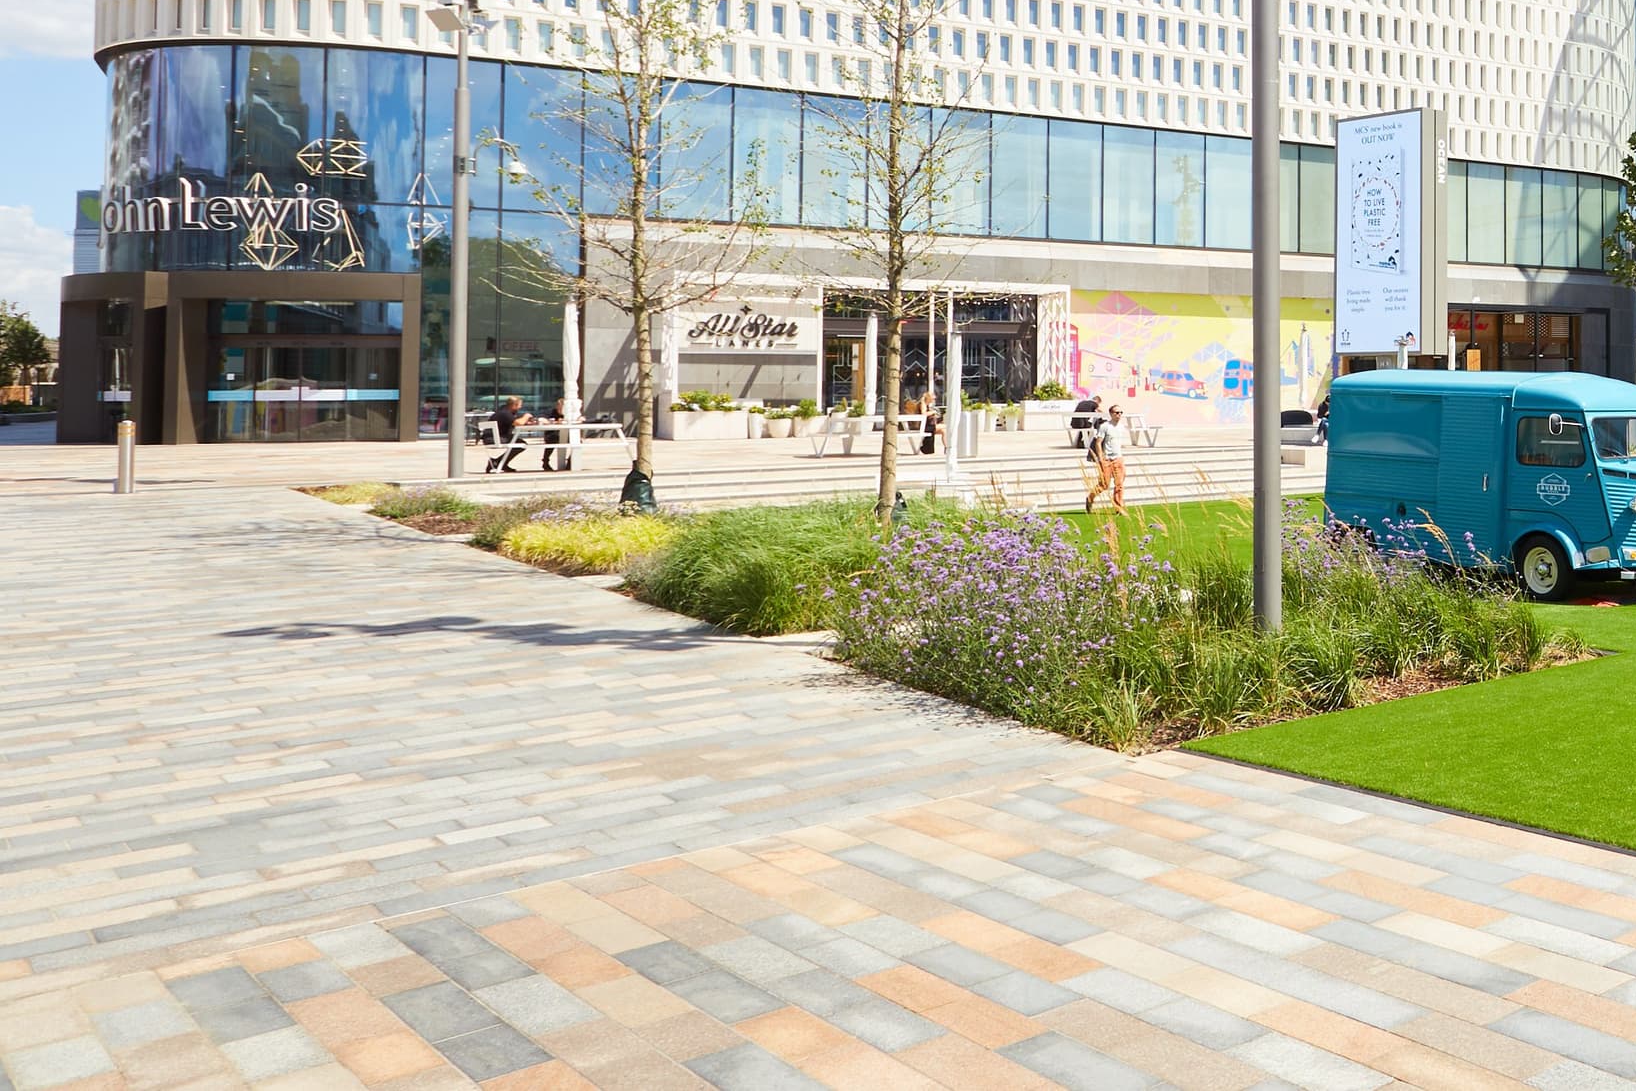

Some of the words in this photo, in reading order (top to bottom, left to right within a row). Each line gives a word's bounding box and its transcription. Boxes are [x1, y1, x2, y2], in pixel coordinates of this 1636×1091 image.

[1438, 139, 1446, 184] OCEAN
[1366, 189, 1382, 197] HOW
[100, 185, 170, 234] ohn
[180, 178, 340, 232] Lewis
[1373, 198, 1385, 207] LIVE
[1363, 208, 1386, 217] PLASTIC
[1367, 218, 1381, 226] FREE
[688, 313, 740, 338] All
[741, 313, 798, 339] Star
[716, 339, 774, 347] LANES
